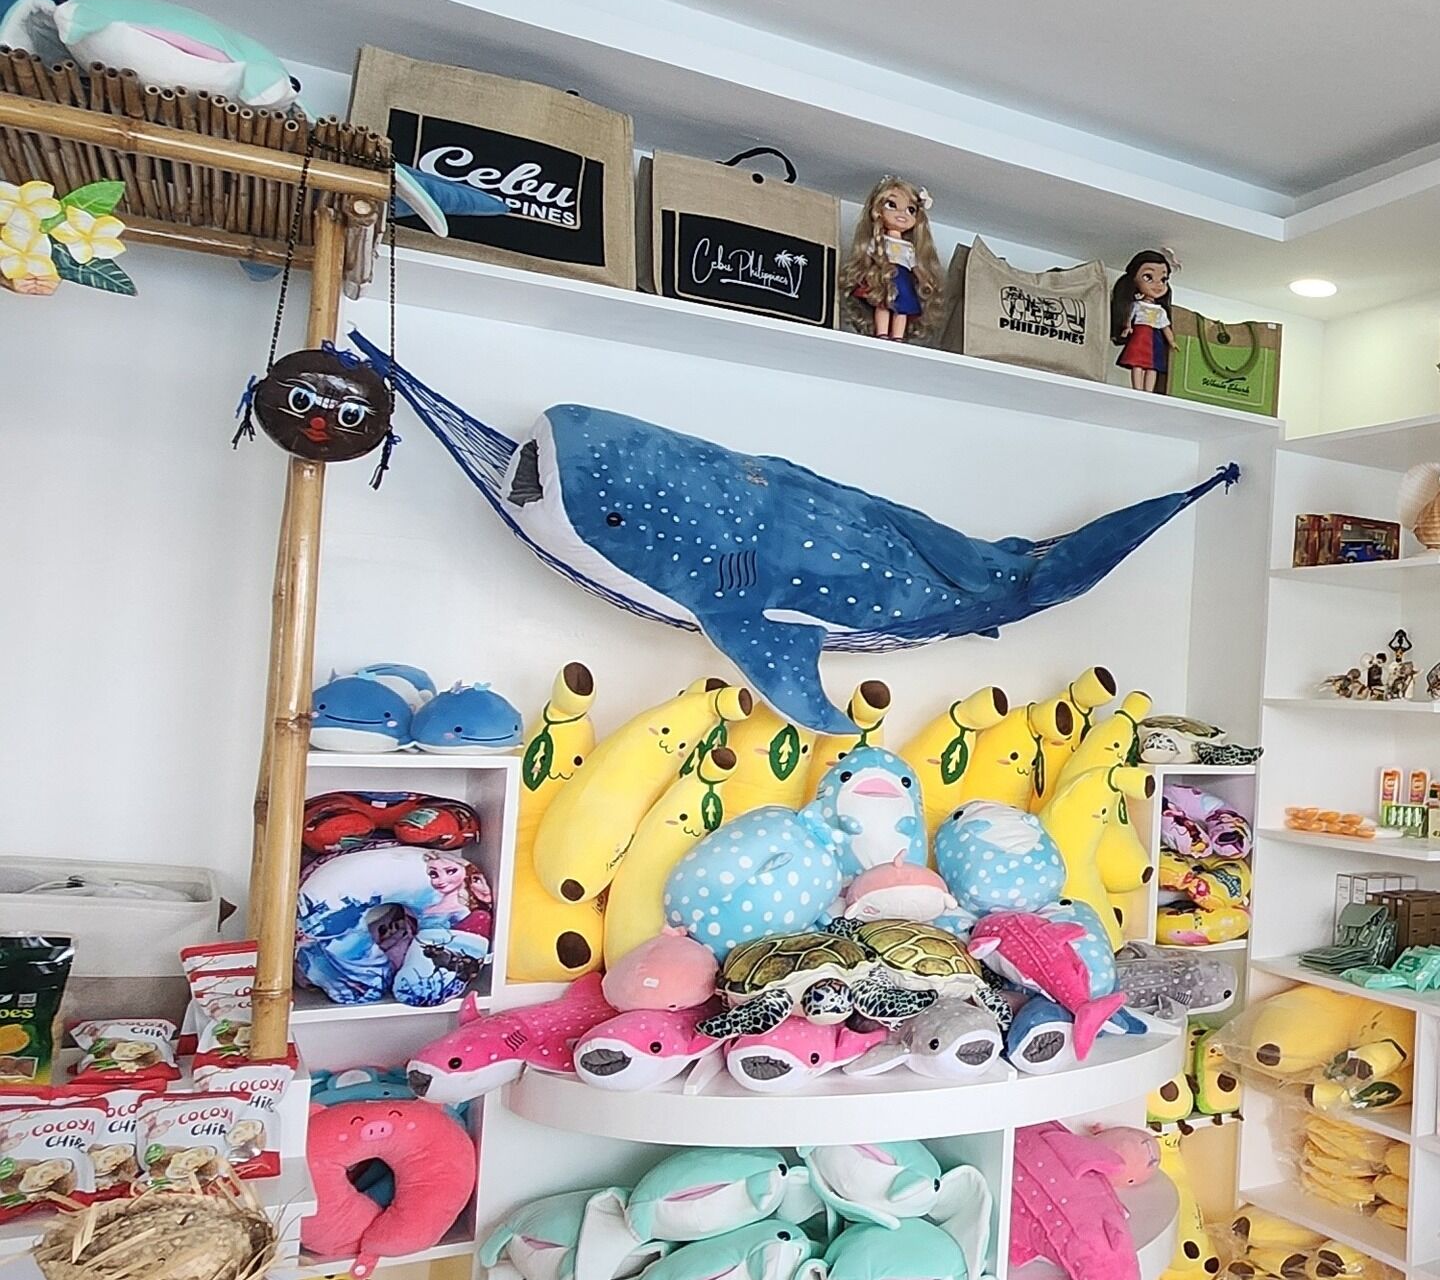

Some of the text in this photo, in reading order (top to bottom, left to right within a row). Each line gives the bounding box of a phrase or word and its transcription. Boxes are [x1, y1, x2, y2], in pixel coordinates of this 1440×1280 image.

[418, 146, 575, 207] Cebu
[692, 238, 788, 287] Cebu Philippines
[999, 317, 1085, 345] PHILIPPINES
[230, 1079, 284, 1093] COCOYA
[106, 1103, 137, 1118] OCO
[178, 1108, 233, 1124] COCOYA
[32, 1119, 96, 1136] COCOYA
[108, 1120, 136, 1133] CHi
